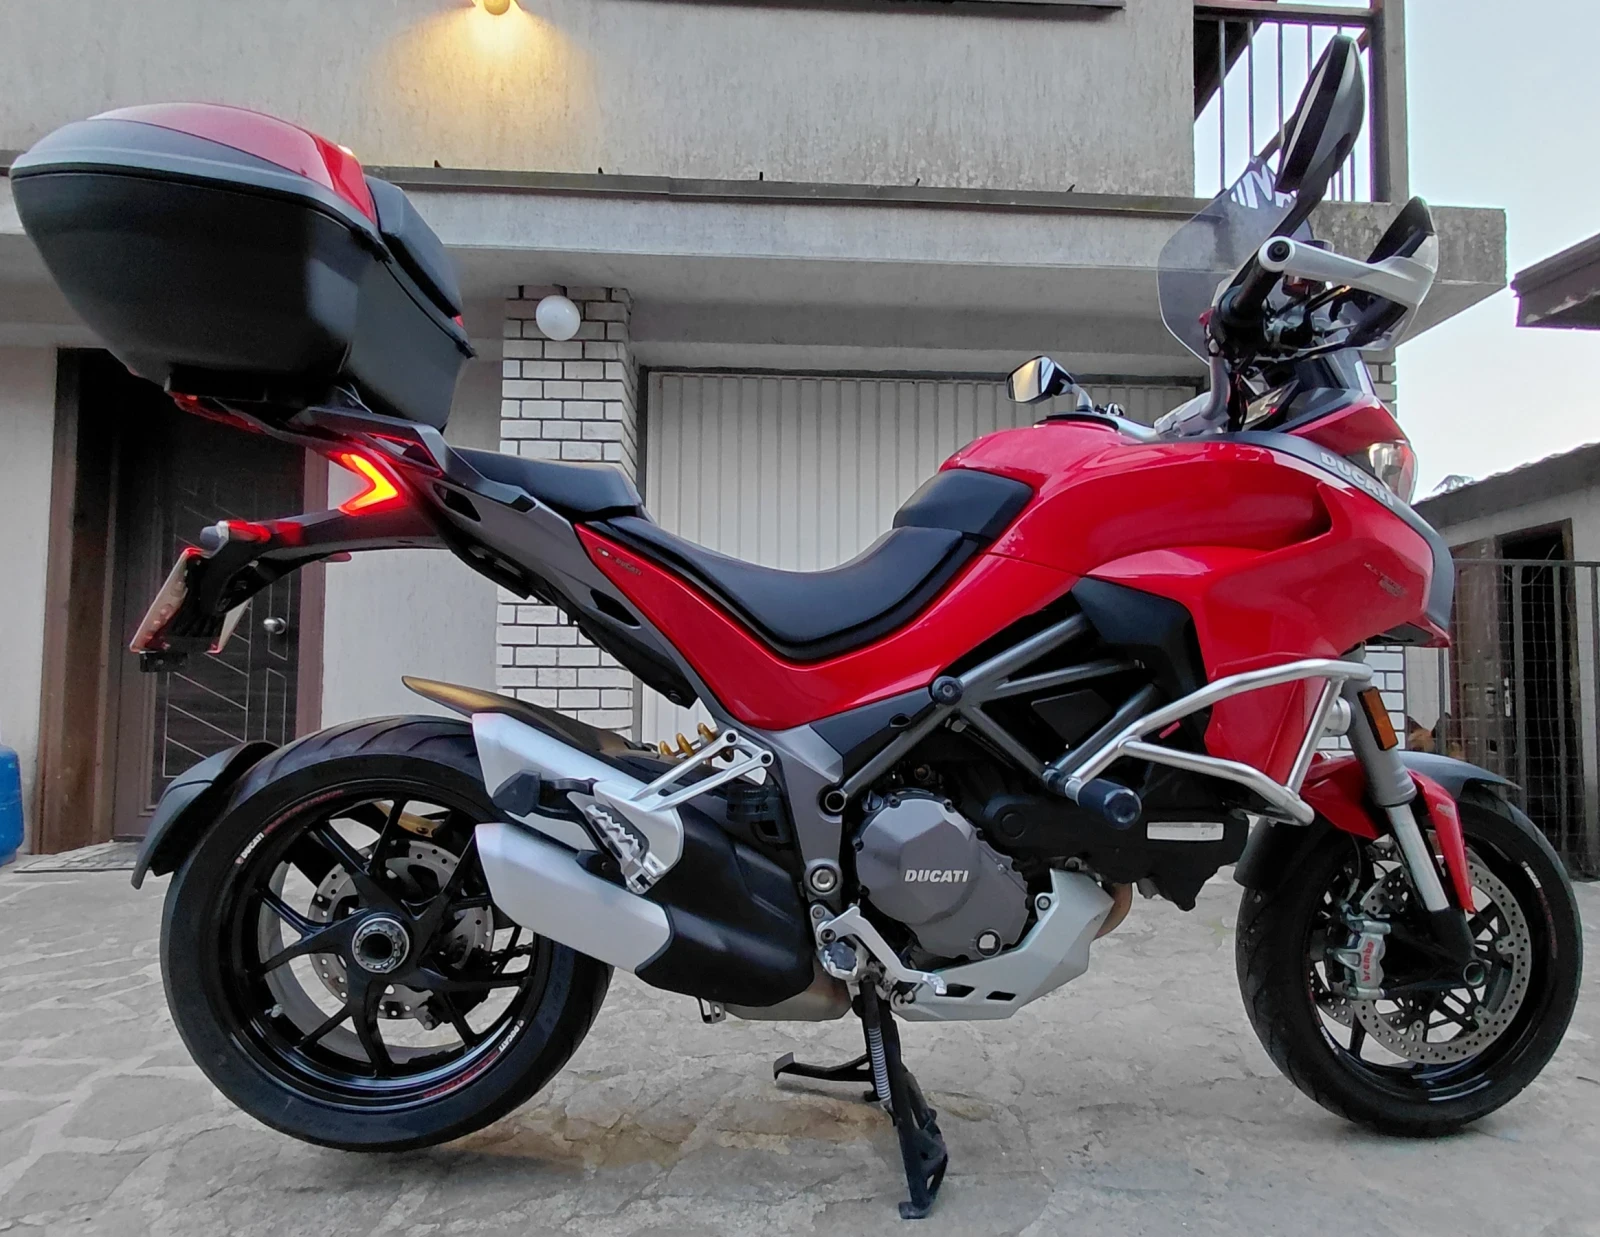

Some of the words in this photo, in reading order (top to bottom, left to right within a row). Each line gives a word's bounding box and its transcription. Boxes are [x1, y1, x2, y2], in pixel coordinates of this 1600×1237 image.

[1320, 452, 1394, 507] DUCATI
[240, 832, 265, 859] DUCATI
[904, 869, 969, 883] DUCATI
[1362, 941, 1375, 982] brembo
